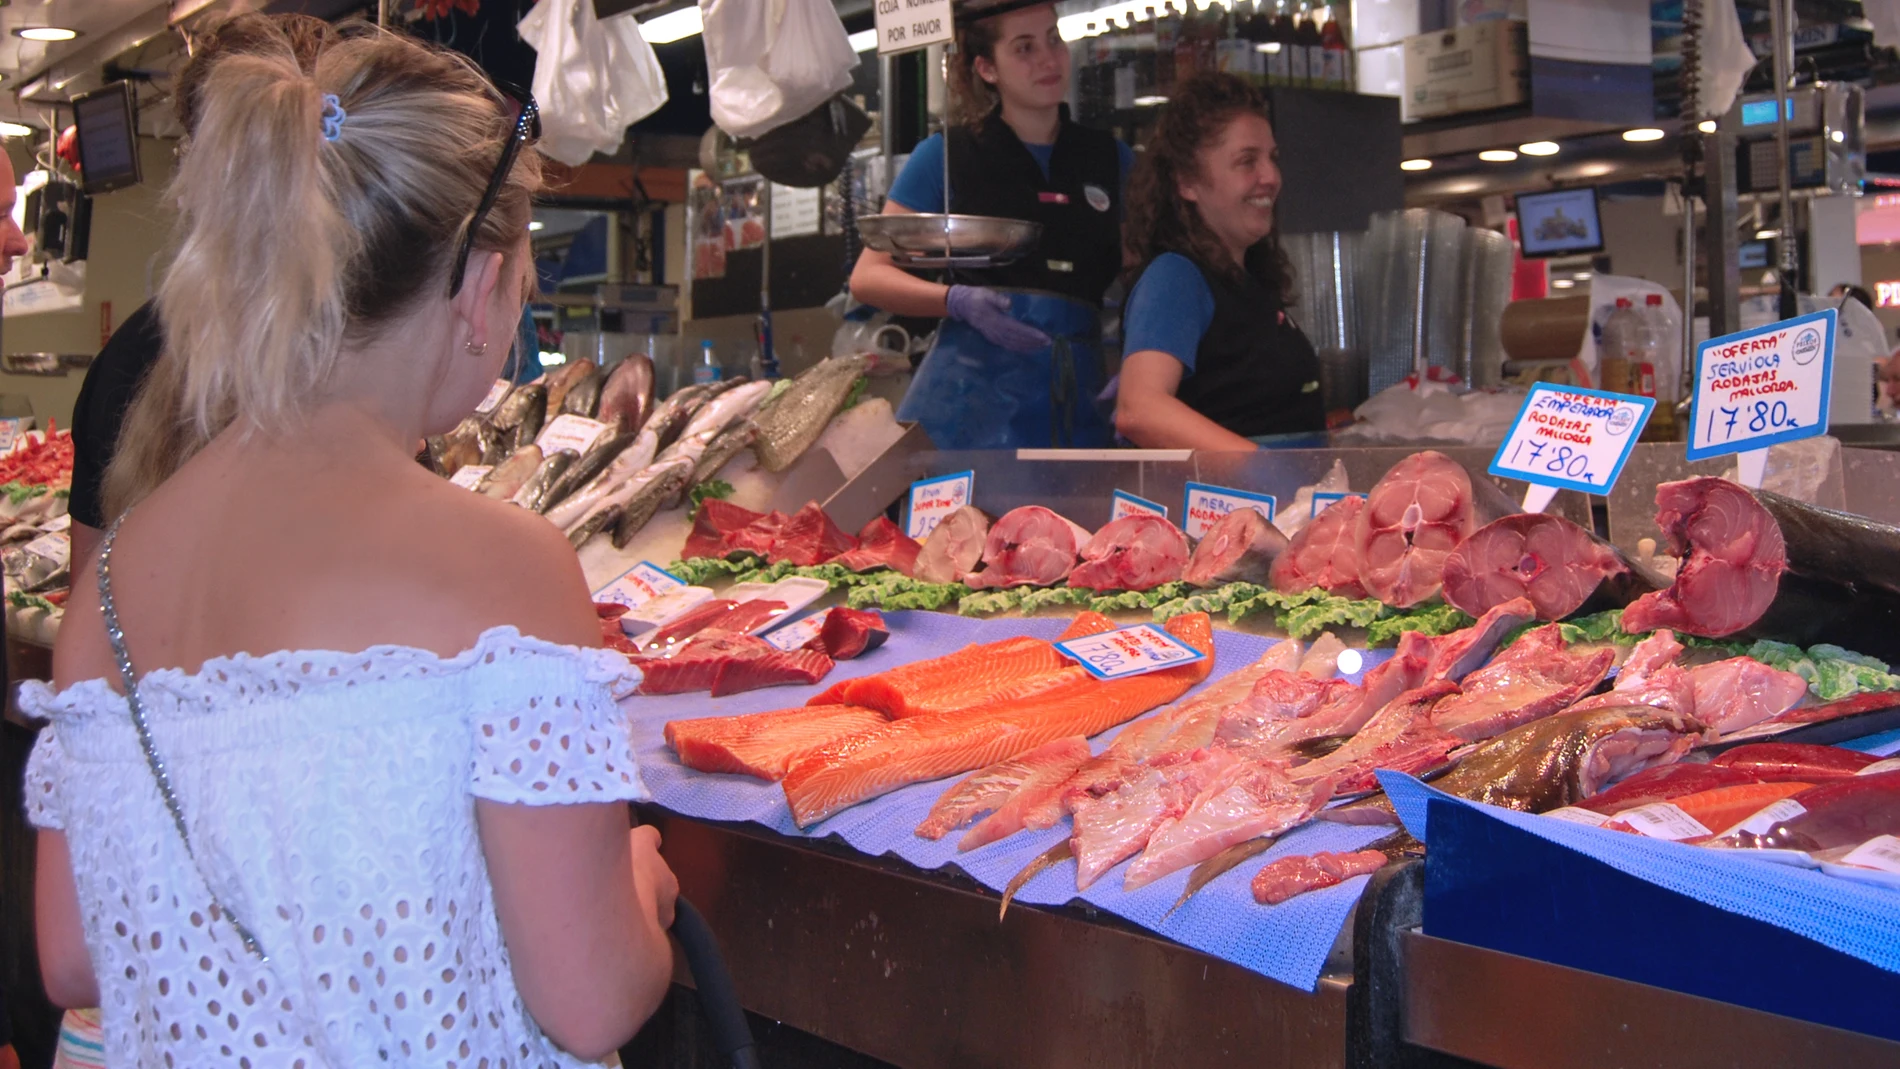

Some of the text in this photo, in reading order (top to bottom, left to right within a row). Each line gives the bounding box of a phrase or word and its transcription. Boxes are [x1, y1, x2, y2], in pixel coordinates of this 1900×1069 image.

[879, 0, 899, 14] COJA
[888, 18, 941, 42] POR FAVOR
[1711, 370, 1777, 392] RODAJAS
[1528, 410, 1592, 433] RODAJAS
